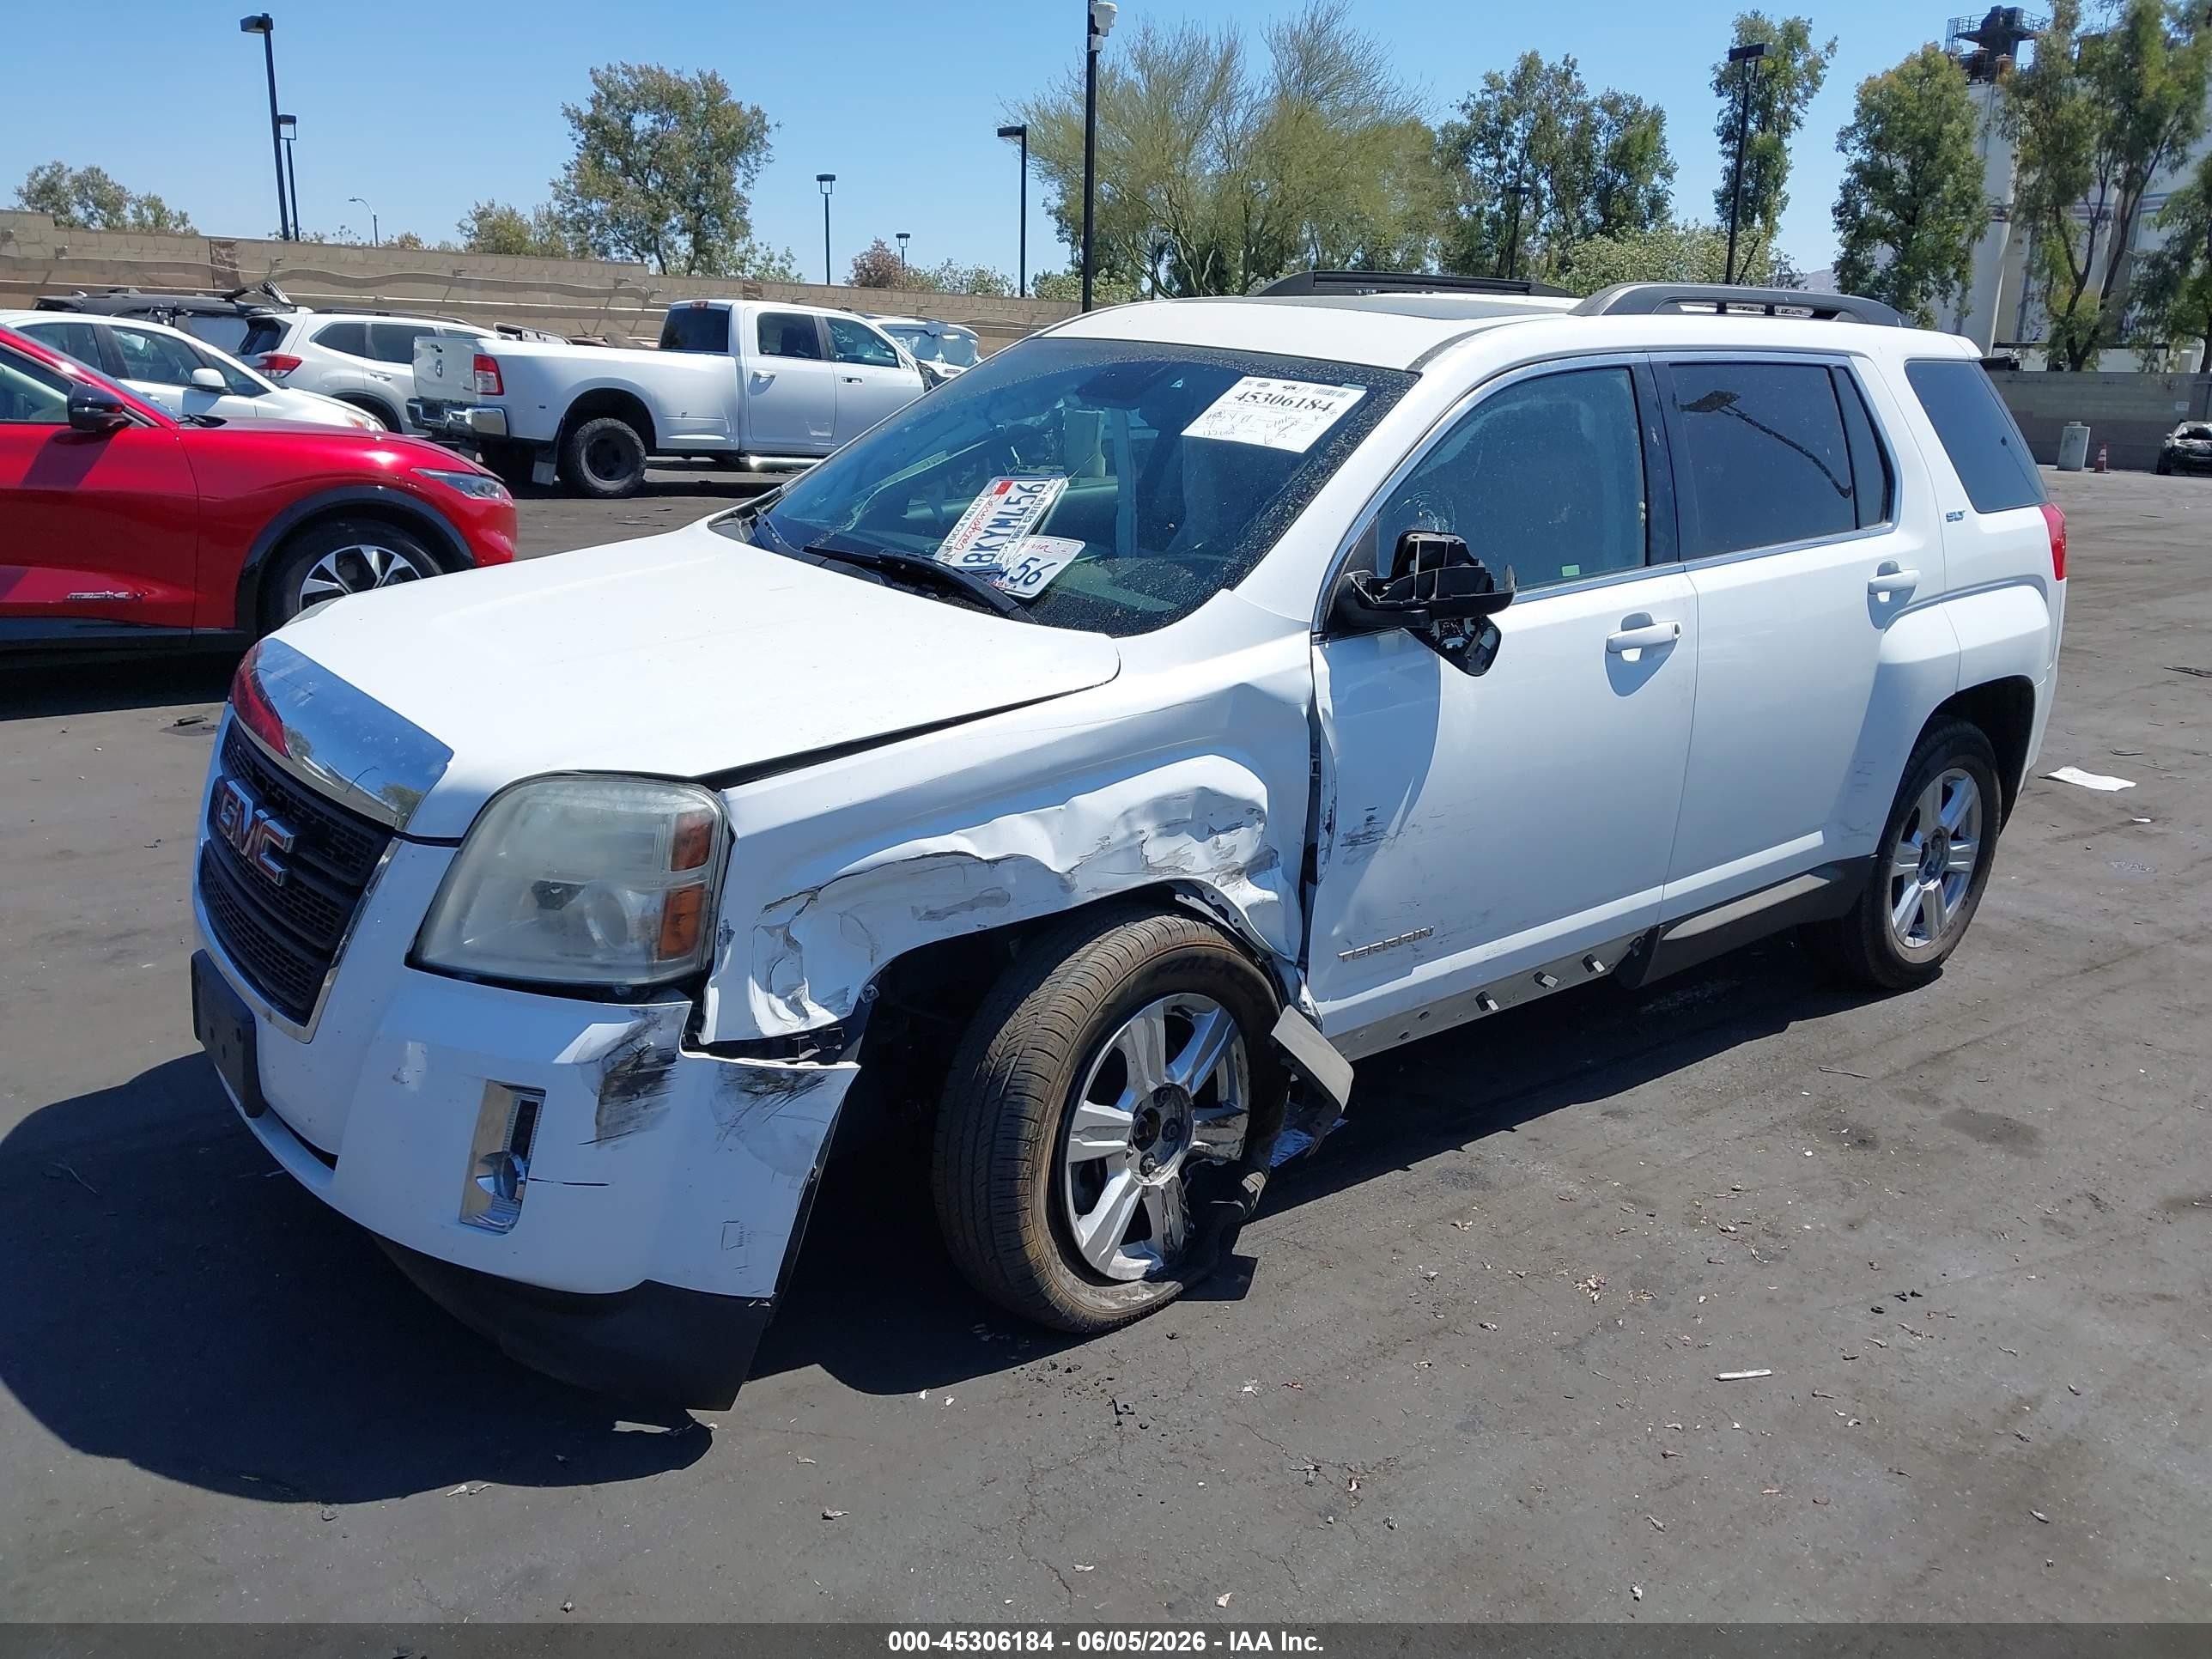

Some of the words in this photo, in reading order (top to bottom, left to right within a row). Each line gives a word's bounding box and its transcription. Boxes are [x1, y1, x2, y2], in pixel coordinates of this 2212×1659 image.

[1235, 391, 1335, 412] 45306184
[945, 522, 968, 545] YUCCA
[217, 781, 296, 886] GMC
[1338, 926, 1434, 962] TERRAIN
